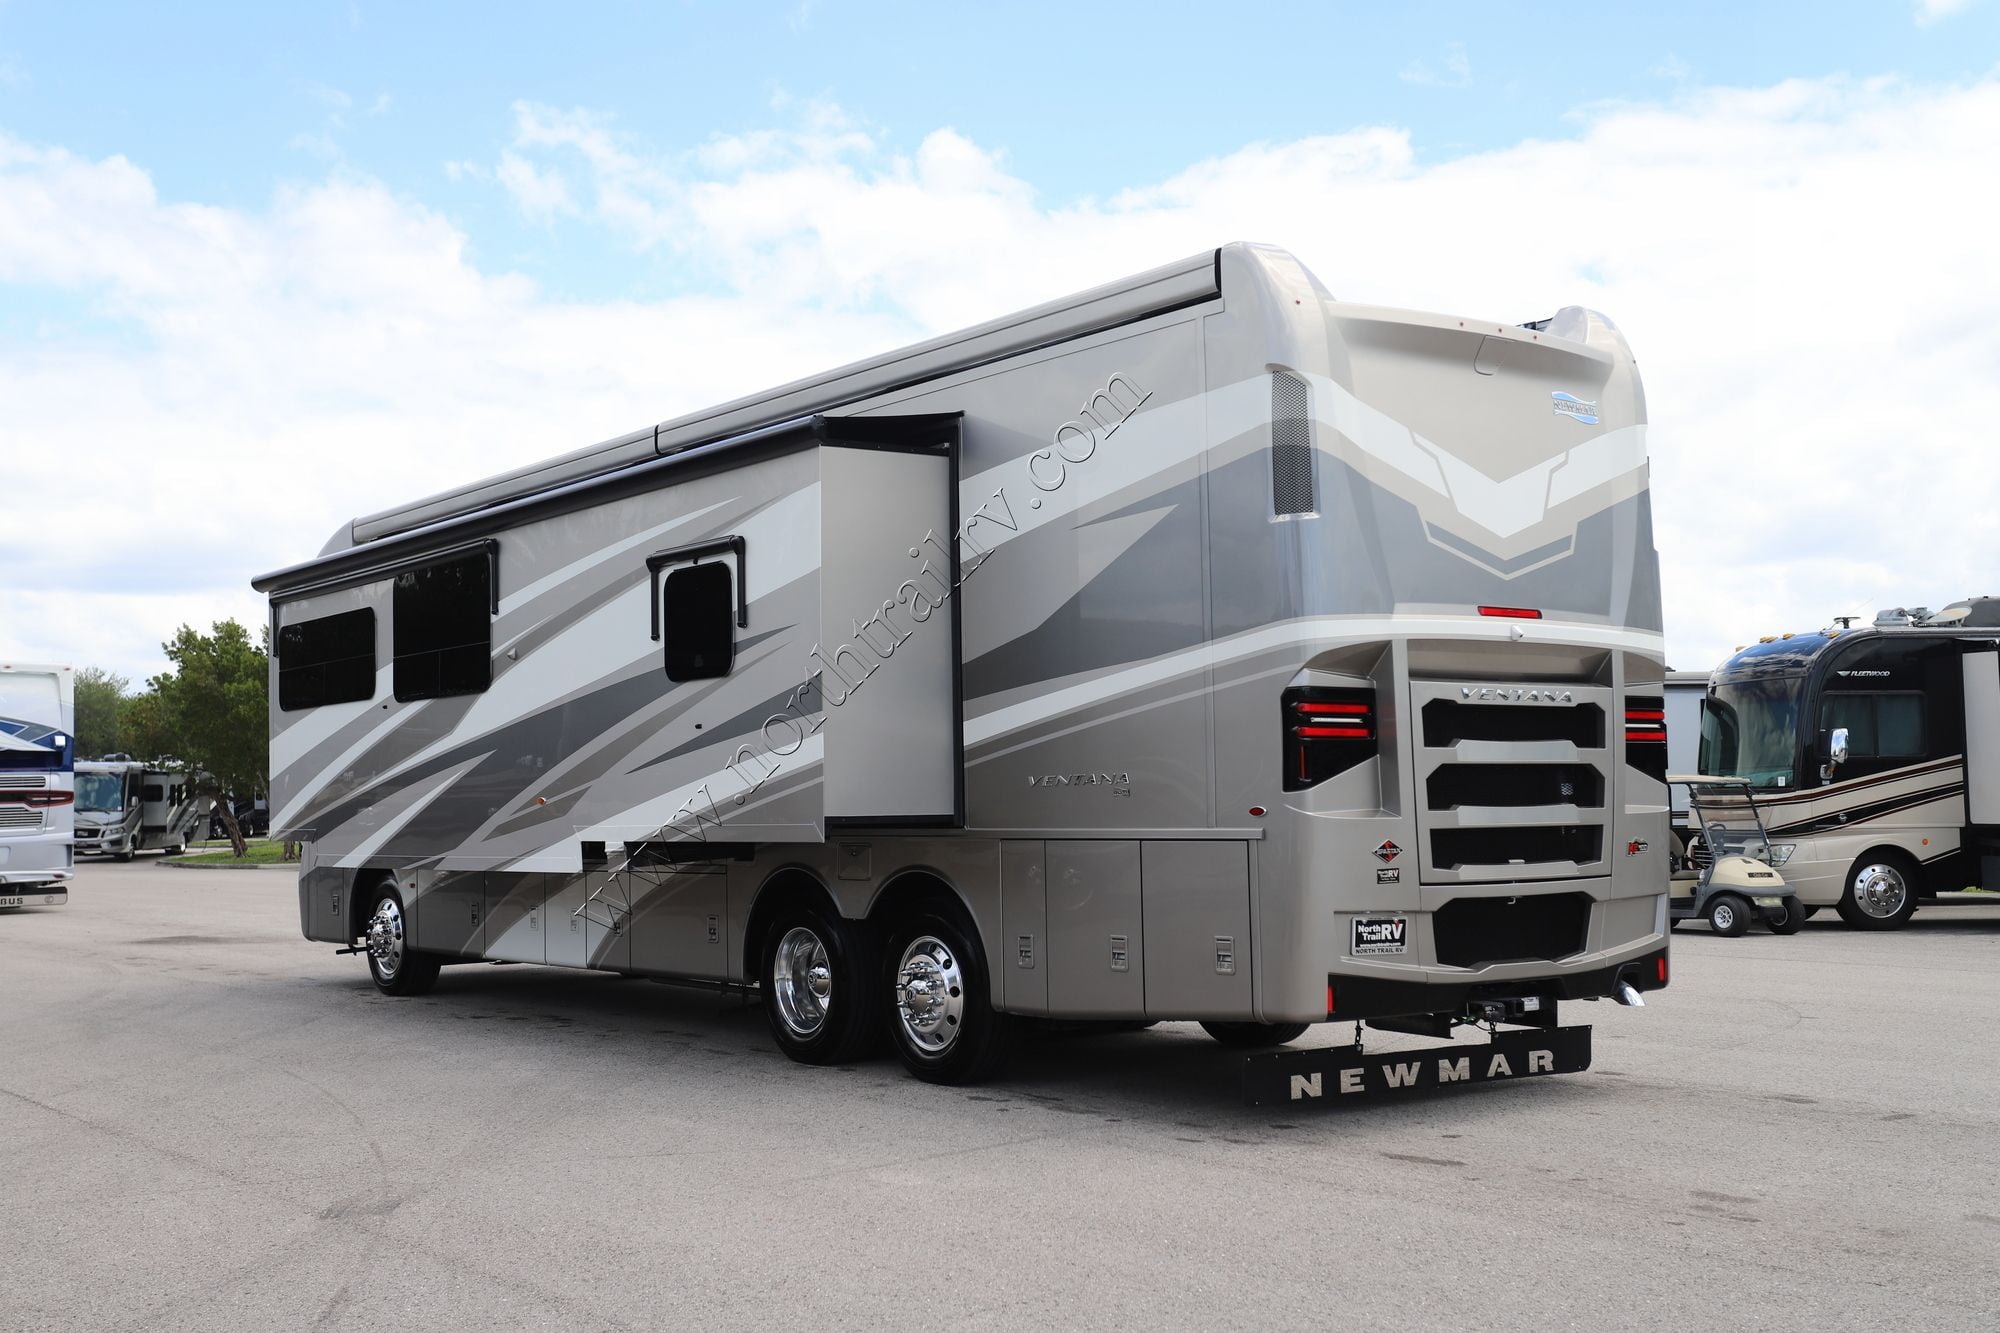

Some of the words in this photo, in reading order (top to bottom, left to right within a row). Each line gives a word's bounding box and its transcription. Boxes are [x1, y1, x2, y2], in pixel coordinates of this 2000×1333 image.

[1460, 687, 1573, 703] VENTANA
[1027, 772, 1130, 787] VENTANA
[1358, 924, 1381, 933] North
[1381, 923, 1403, 940] RV
[1362, 932, 1381, 941] Trail
[1290, 1049, 1554, 1101] NEWMAR
